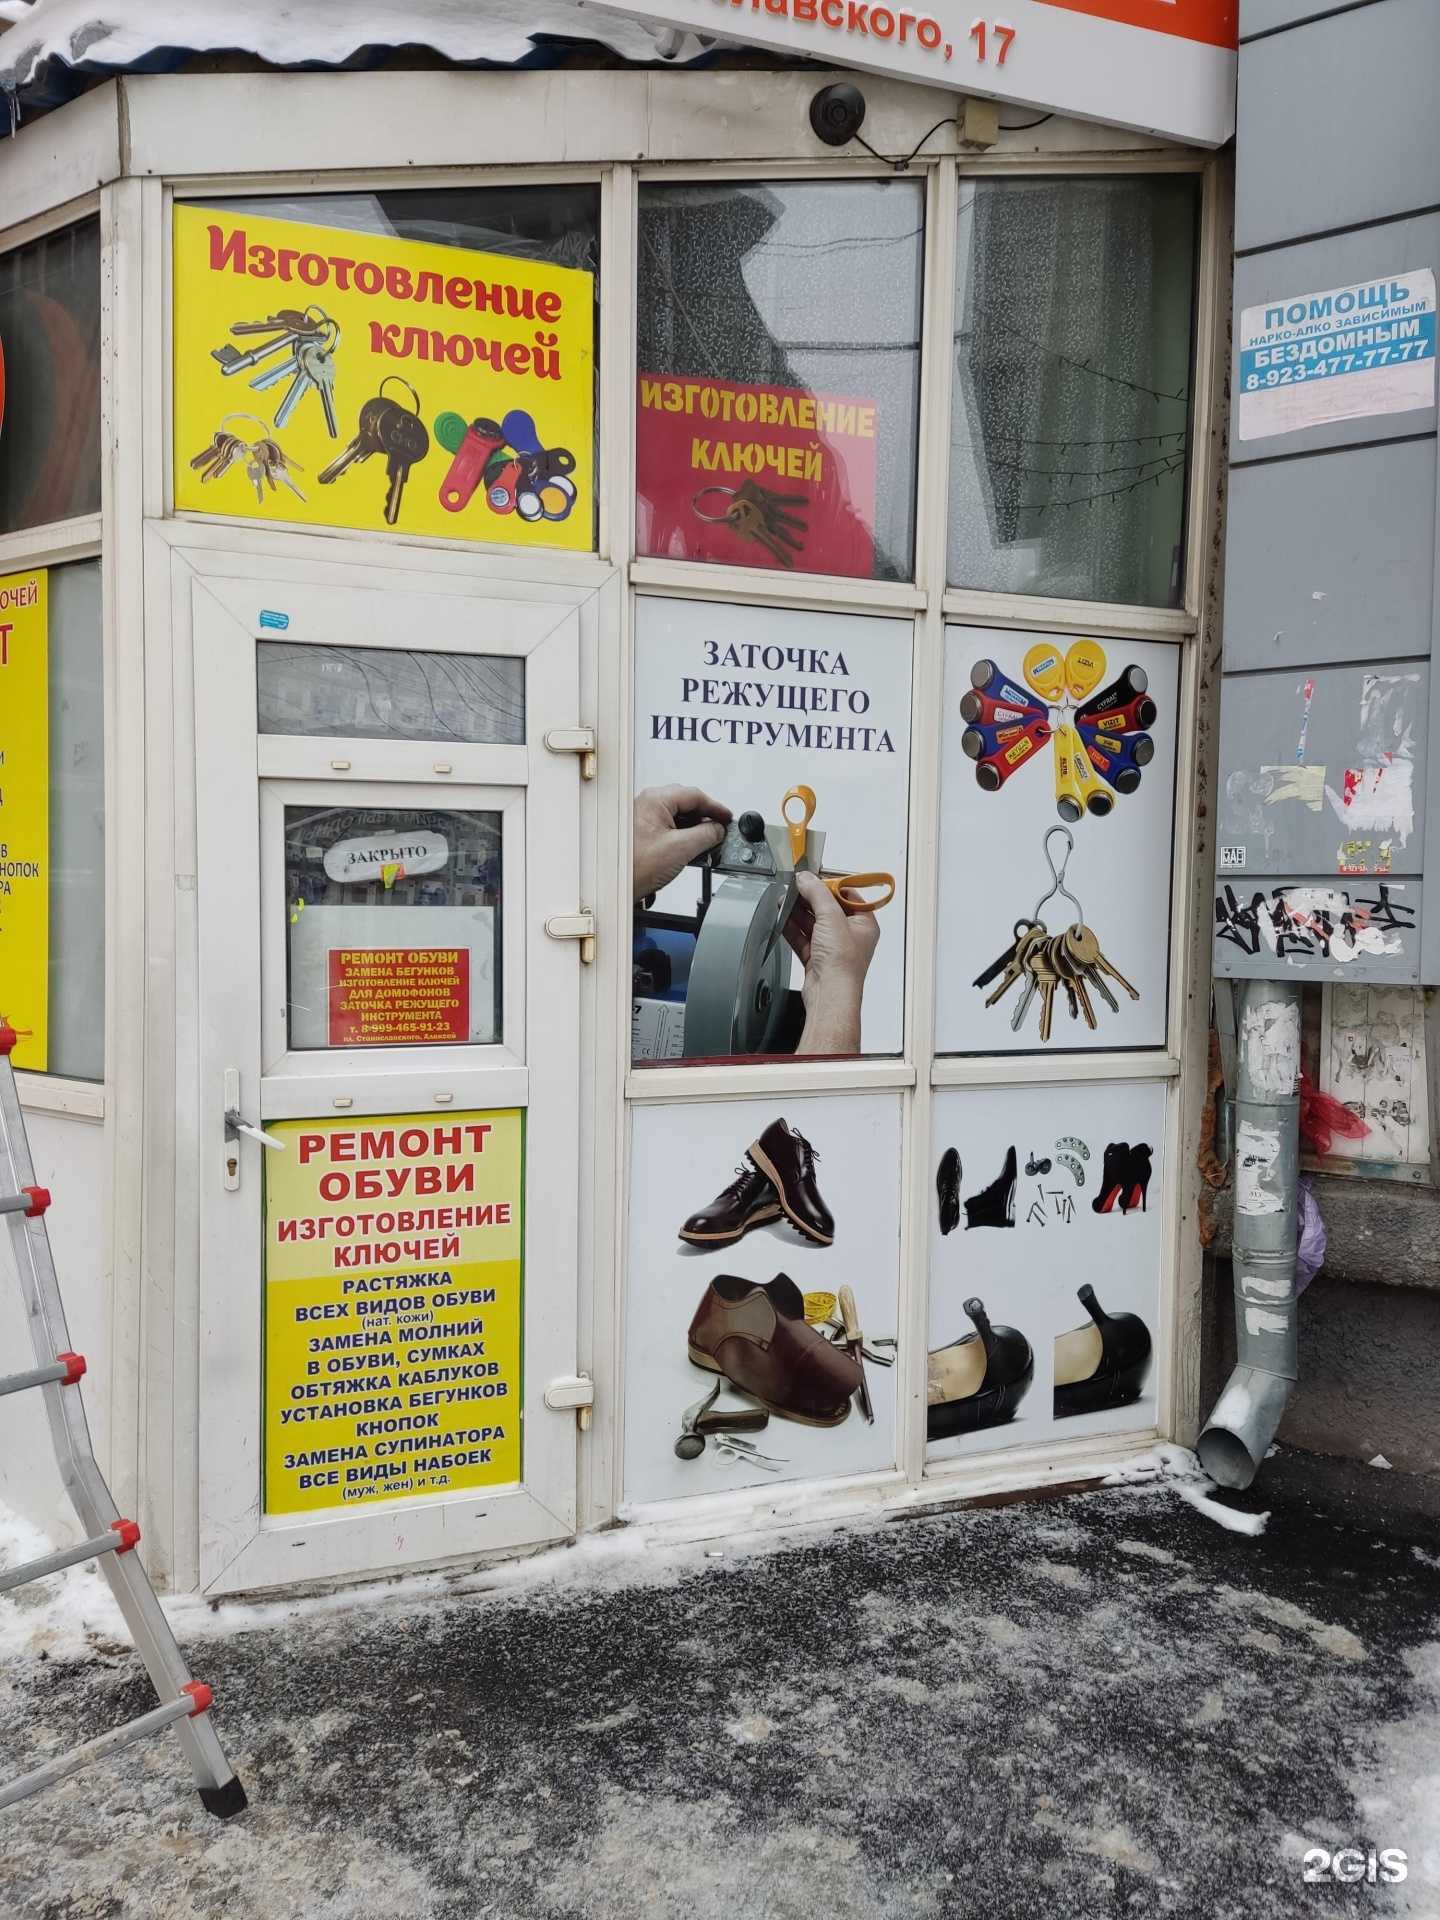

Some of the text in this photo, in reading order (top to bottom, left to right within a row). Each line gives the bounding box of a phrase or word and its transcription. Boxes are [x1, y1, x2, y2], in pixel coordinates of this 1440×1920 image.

[968, 20, 1017, 64] 17
[207, 224, 562, 323] Изготовление
[1250, 301, 1427, 346] НАРКО-АЛКО ЗАВИСИМЫМ
[1265, 282, 1410, 330] ПОМОЩЬ
[368, 321, 562, 381] ключей
[1255, 319, 1421, 368] БЕЗДОМНЫМ
[1246, 339, 1429, 390] 8-923-477-77-77
[640, 379, 876, 437] ИЗГОТОВЛЕНИЕ
[691, 438, 822, 482] КЛЮЧЕЙ
[704, 640, 850, 675] ЗАТОЧКА
[681, 678, 870, 716] РЕЖУЩЕГО
[650, 715, 896, 753] ИНСТРУМЕНТА
[347, 846, 428, 864] ЗАКРЫТО
[341, 951, 458, 965] РЕМОНТ ОБУВИ
[345, 966, 455, 977] ЗАМЕНА БЕГУНКОВ
[339, 975, 460, 987] ИЗГОТОВЛЕНИЕ КЛЮЧЕЙ
[349, 988, 451, 1000] ДЛЯ ДОМОФОНОВ
[340, 999, 459, 1010] ЗАТОЧКА РЕЖУЩЕГО
[361, 1011, 442, 1021] ИНСТРУМЕНТА
[299, 1125, 492, 1164] РЕМОНТ
[319, 1163, 474, 1202] ОБУВИ
[277, 1204, 511, 1242] ИЗГОТОВЛЕНИЕ
[334, 1233, 460, 1268] КЛЮЧЕЙ
[343, 1271, 452, 1294] РАСТЯЖКА
[295, 1289, 496, 1322] ВСЕХ ВИДОВ ОБУВИ
[362, 1310, 434, 1330] (нат. кожи)
[309, 1319, 483, 1352] ЗАМЕНА МОЛНИЙ
[307, 1342, 485, 1375] В ОБУВИ, СУМКАХ
[291, 1362, 499, 1400] ОБТЯЖКА КАБЛУКОВ
[280, 1382, 508, 1424] УСТАНОВКА БЕГУНКОВ
[356, 1413, 439, 1437] КНОПОК
[284, 1426, 506, 1469] ЗАМЕНА СУПИНАТОРА
[299, 1449, 492, 1489] ВСЕ ВИДЫ НАБОЕК
[342, 1484, 379, 1500] (муж,
[383, 1477, 414, 1492] жен)
[417, 1478, 426, 1487] и
